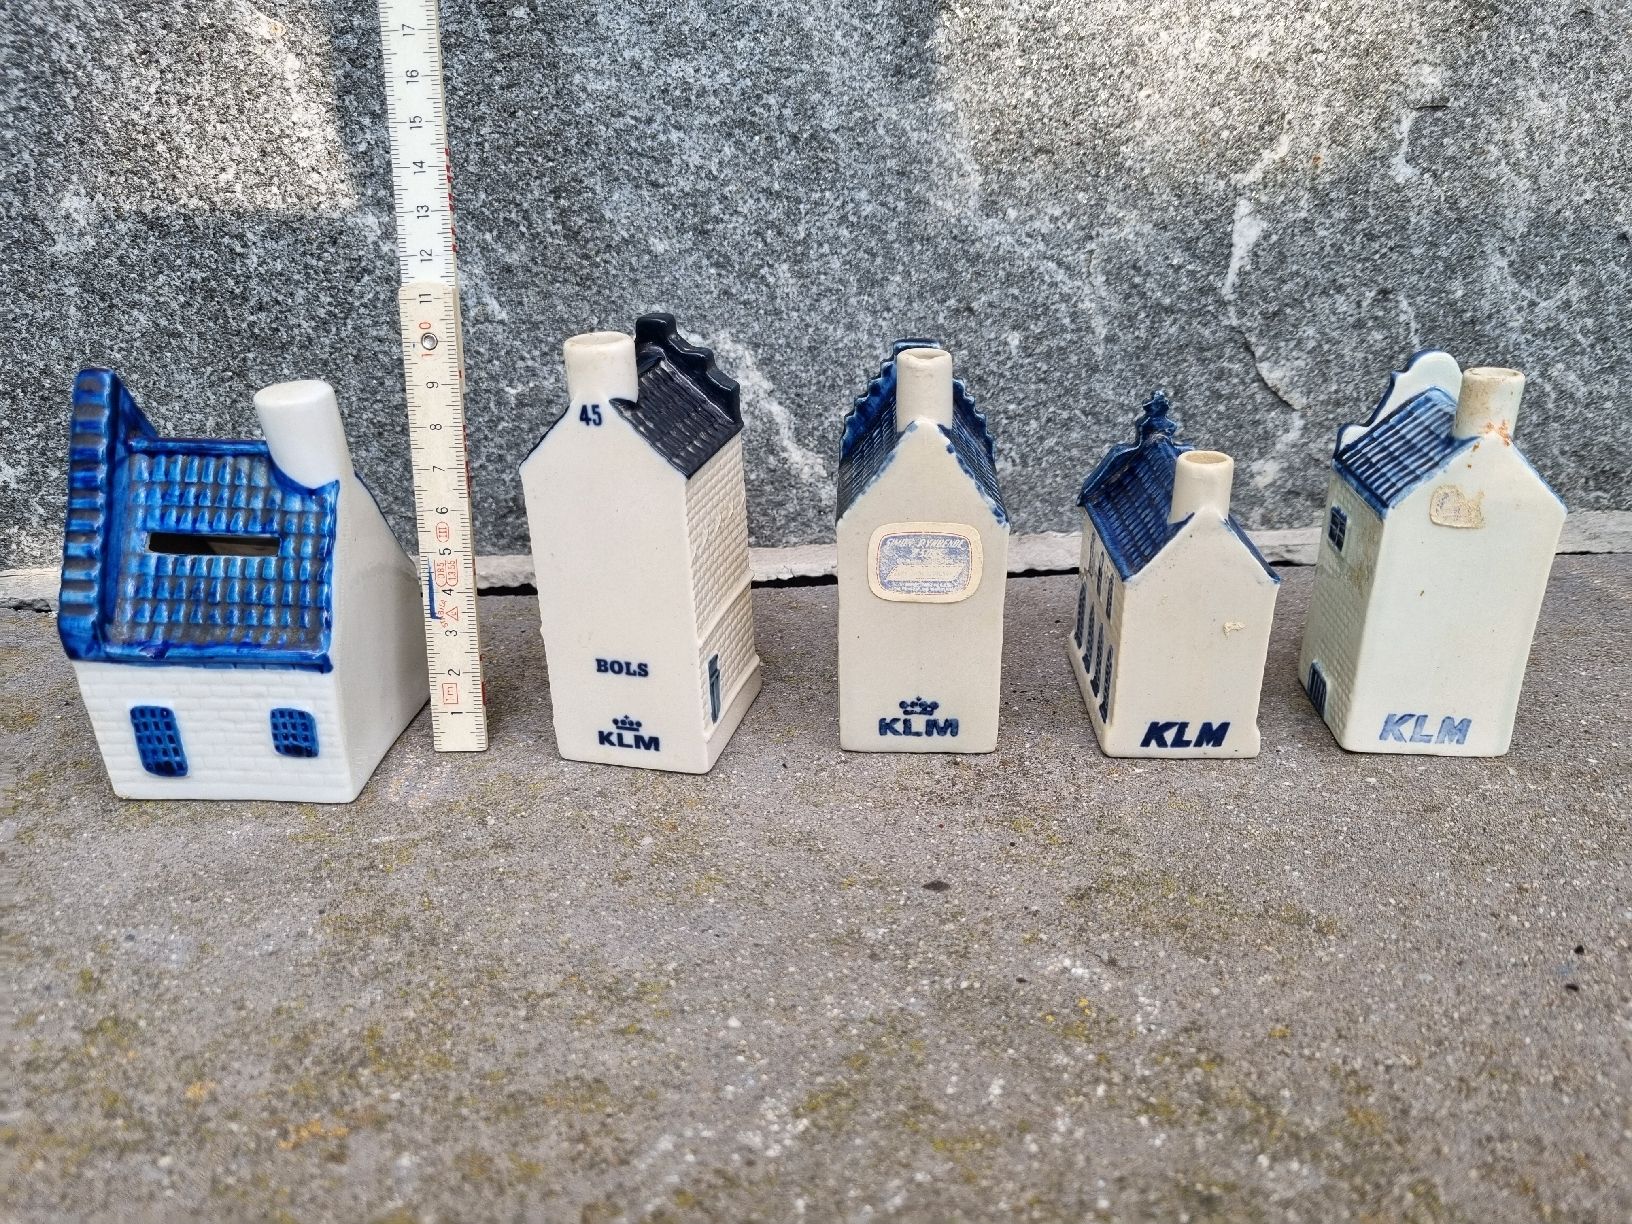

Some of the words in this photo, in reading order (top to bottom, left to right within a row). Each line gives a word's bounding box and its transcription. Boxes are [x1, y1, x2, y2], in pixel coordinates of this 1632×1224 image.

[401, 23, 416, 37] 17
[405, 69, 420, 85] 16
[408, 115, 424, 131] 15
[412, 160, 427, 175] 14
[416, 204, 430, 219] 13
[419, 248, 433, 263] 12
[418, 293, 433, 304] 11
[425, 381, 439, 389] 9
[579, 404, 603, 427] 45
[429, 423, 443, 431] 8
[432, 465, 446, 473] 7
[435, 506, 449, 515] 6
[438, 547, 452, 556] 5
[441, 588, 455, 596] 4
[444, 629, 458, 637] 3
[447, 668, 461, 677] 2
[595, 658, 649, 678] BOLS
[878, 717, 959, 737] KLM
[1140, 721, 1231, 748] KLM
[1379, 713, 1472, 745] KLM
[597, 730, 660, 752] KLM
